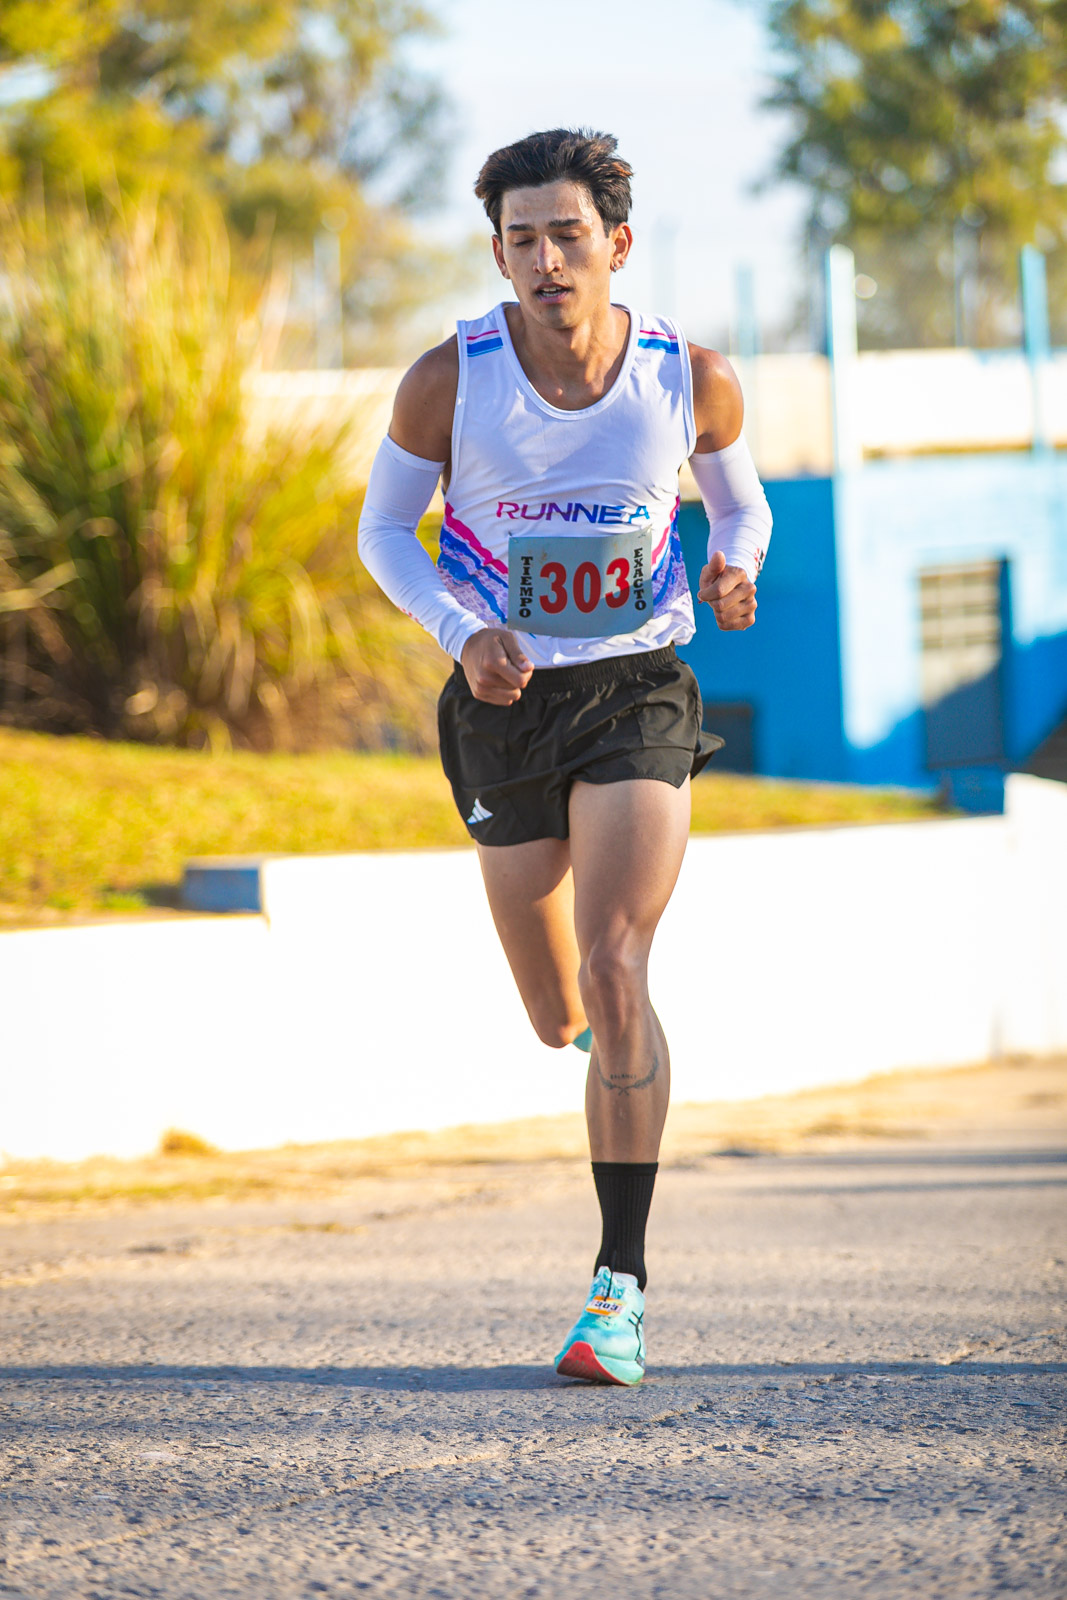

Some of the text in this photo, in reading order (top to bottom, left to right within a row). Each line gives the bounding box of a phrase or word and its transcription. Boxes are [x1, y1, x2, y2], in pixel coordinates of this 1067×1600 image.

[496, 501, 650, 524] RUNNEA
[518, 556, 533, 618] TIEMPO
[539, 557, 630, 614] 303
[633, 547, 646, 611] EXACTO
